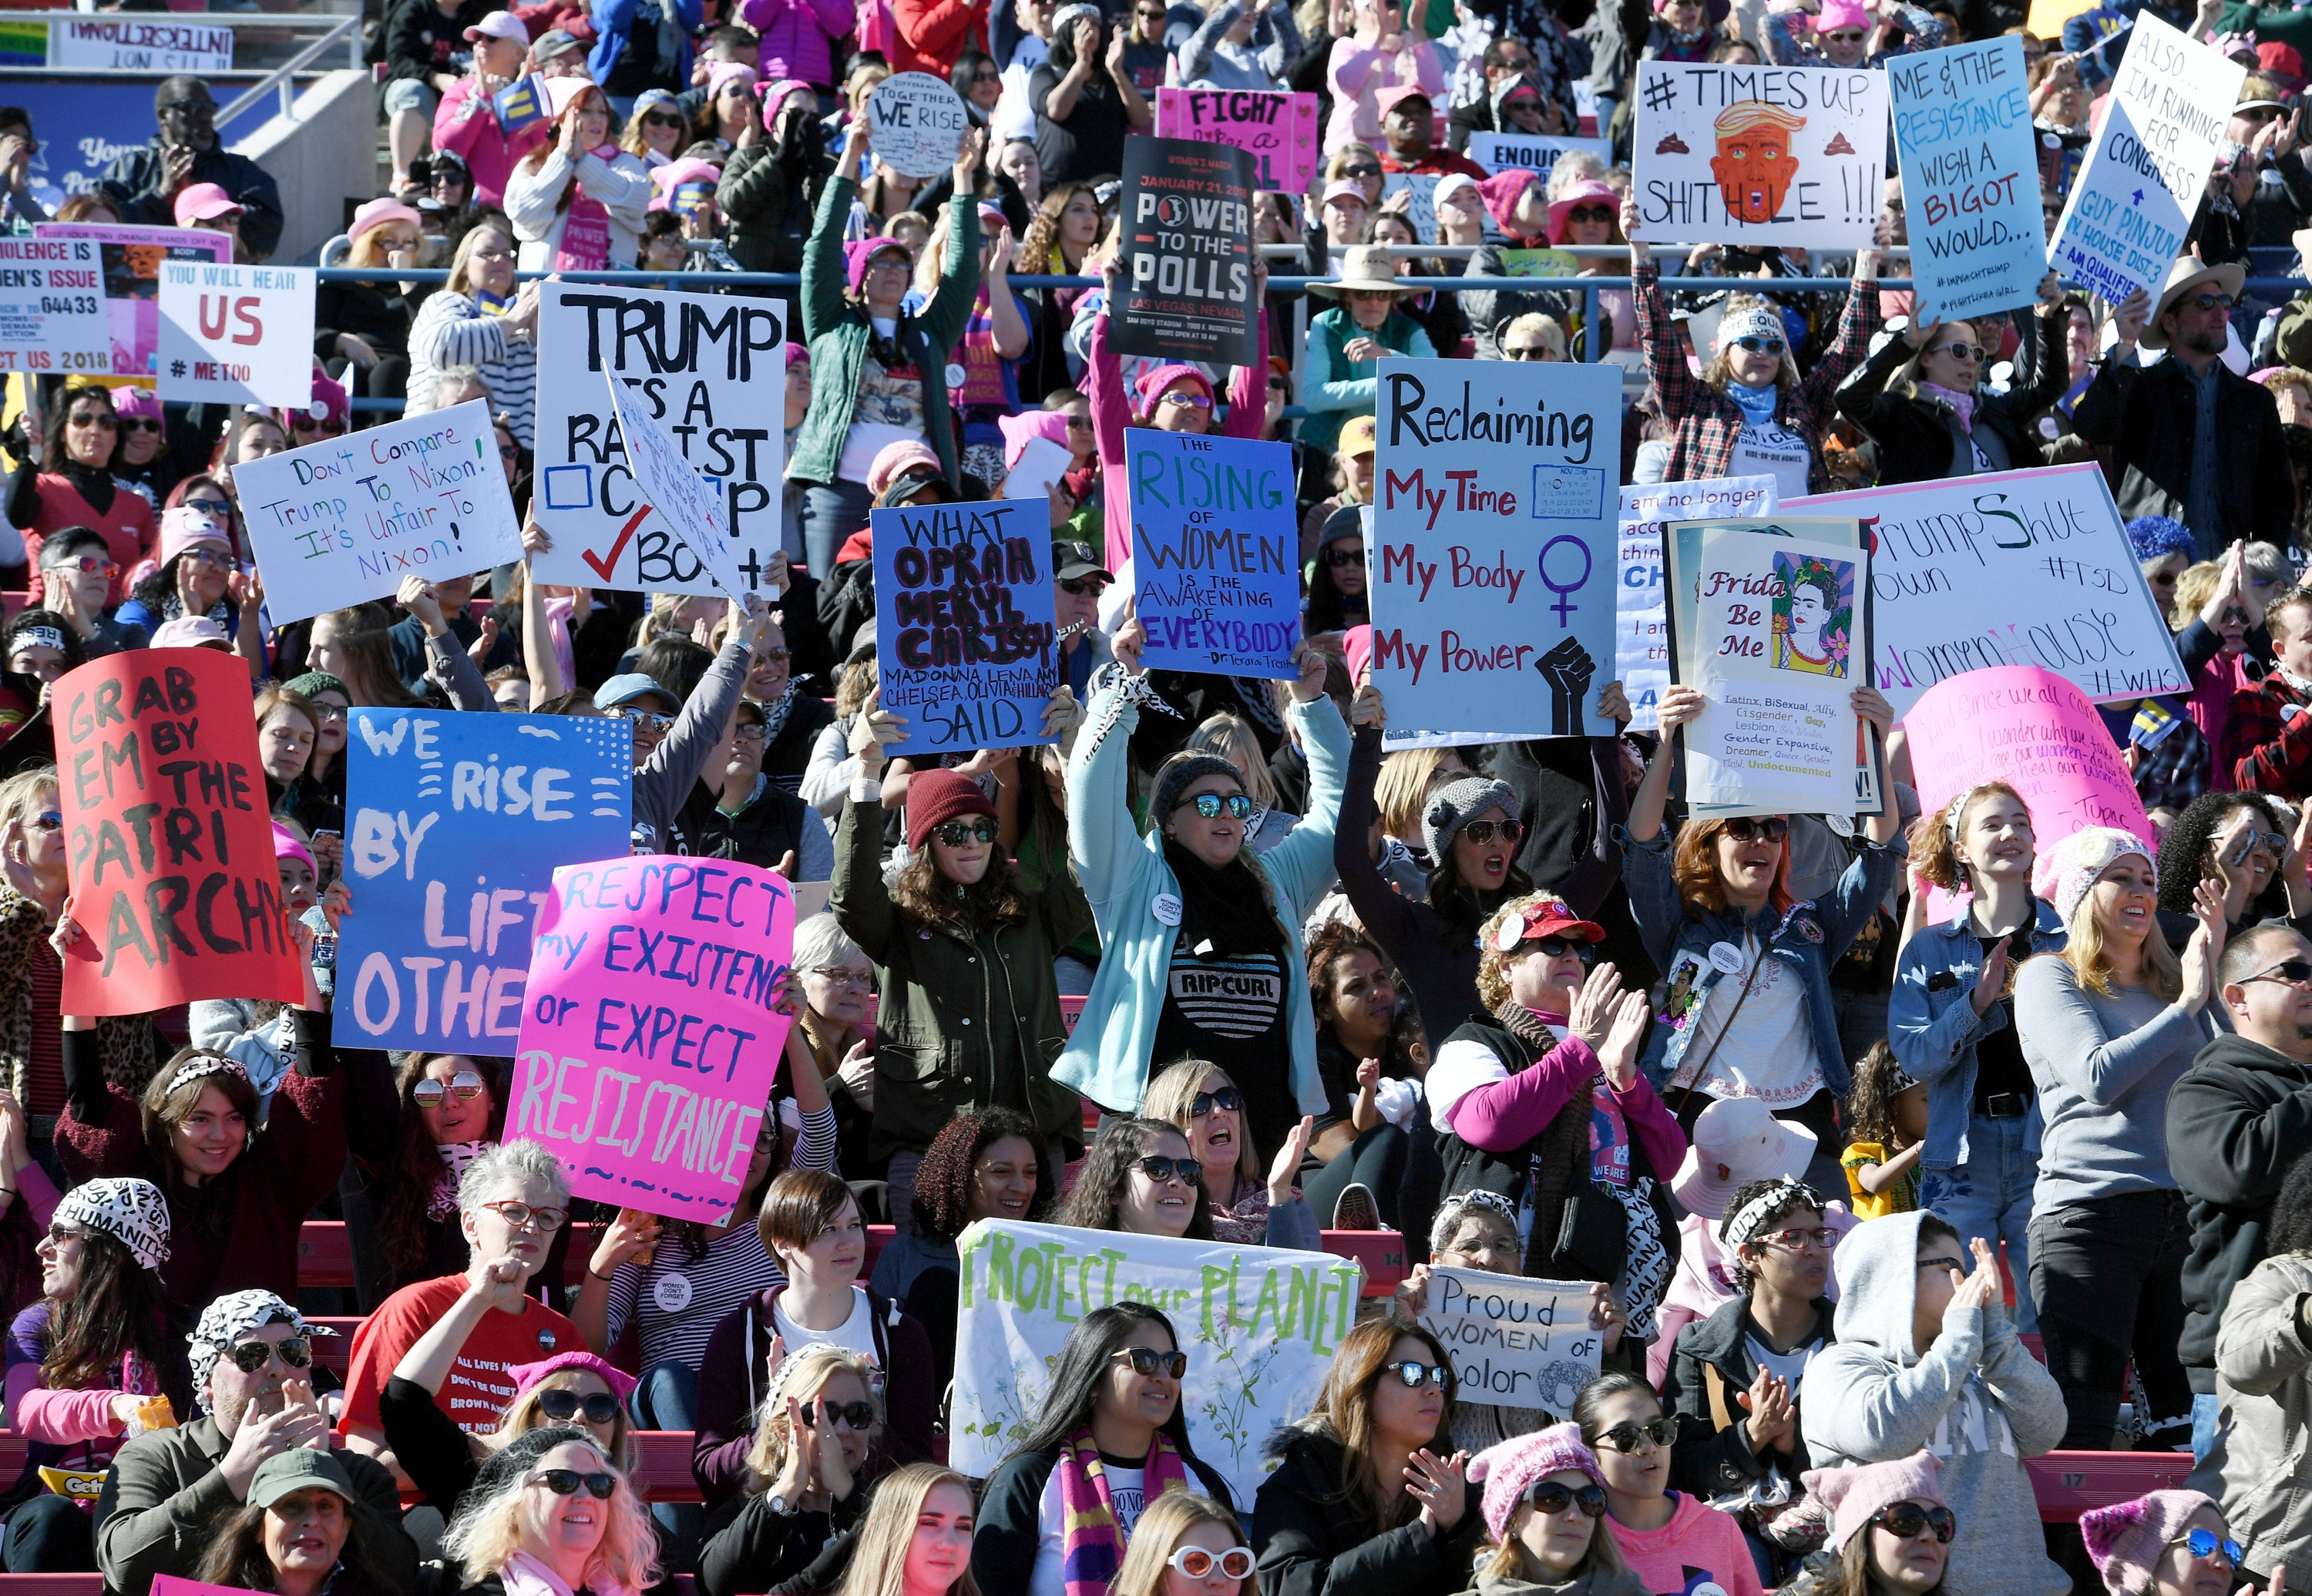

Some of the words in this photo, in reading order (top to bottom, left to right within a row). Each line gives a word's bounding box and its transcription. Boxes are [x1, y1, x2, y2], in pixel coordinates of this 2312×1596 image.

[1685, 69, 1808, 109] TIMES
[1892, 62, 1934, 104] ME
[1960, 48, 2006, 97] THE
[877, 86, 958, 106] TOGETHER
[1189, 91, 1287, 125] FIGHT
[2124, 66, 2159, 109] I'M
[2162, 86, 2224, 146] RUNNING
[874, 99, 912, 128] WE
[918, 107, 963, 130] RISE
[1896, 86, 2027, 159] RESISTANCE
[1252, 132, 1280, 149] a
[2146, 118, 2179, 153] FOR
[1920, 151, 1973, 189] WISH
[1974, 141, 1998, 173] A
[2109, 133, 2196, 201] CONGRESS
[1141, 176, 1205, 192] JANUARY
[1924, 172, 2019, 227] BIGOT
[2081, 190, 2119, 227] GUY
[75, 244, 90, 260] IS
[157, 236, 187, 244] HANDS
[173, 247, 197, 256] BODY
[1157, 231, 1185, 250] TO
[1191, 235, 1232, 256] THE
[2055, 239, 2065, 254] I
[2067, 246, 2086, 269] AM
[2081, 224, 2126, 264] HOUSE
[2148, 264, 2162, 284] 3
[49, 270, 98, 287] ISSUE
[166, 265, 196, 284] YOU
[204, 267, 242, 287] WILL
[253, 270, 296, 290] HEAR
[1131, 253, 1248, 302] POLLS
[2072, 268, 2096, 293] FOR
[42, 297, 97, 314] 64433
[199, 294, 263, 346] US
[1129, 298, 1151, 309] LAS
[1201, 305, 1245, 319] NEVADA
[1156, 318, 1182, 328] STADIUM
[560, 293, 782, 384] TRUMP
[29, 351, 52, 368] US
[62, 352, 108, 368] 2018
[684, 380, 714, 428] A
[1386, 373, 1594, 464] Reclaiming
[291, 449, 355, 486] Don't
[370, 425, 464, 465] Compare
[1177, 436, 1212, 452] THE
[260, 497, 349, 529] Trump
[355, 474, 391, 503] To
[408, 438, 486, 493] Nixon!
[1137, 449, 1283, 512] RISING
[1386, 469, 1446, 530] My
[1446, 469, 1517, 516] Time
[1631, 496, 1660, 510] am
[1668, 493, 1693, 507] no
[1699, 488, 1766, 509] longer
[294, 529, 355, 561] It's
[364, 502, 439, 543] Unfair
[439, 489, 476, 520] To
[900, 509, 1014, 548] WHAT
[1189, 511, 1215, 525] OF
[358, 521, 465, 581] Nixon!
[1136, 524, 1285, 575] WOMEN
[1178, 574, 1194, 588] IS
[1208, 574, 1242, 590] THE
[1383, 543, 1438, 603] My
[1447, 545, 1526, 604] Body
[1704, 570, 1787, 598] Frida
[1140, 582, 1274, 609] AWAKENING
[1191, 607, 1215, 622] OF
[1727, 603, 1762, 627] Be
[896, 621, 1054, 670] CHRISSY
[1144, 616, 1298, 654] EVERYBODY
[1718, 634, 1765, 658] Me
[1374, 628, 1429, 686] My
[1441, 630, 1535, 674] Power
[68, 666, 197, 744] GRAB
[967, 680, 1012, 701] OLIVIA
[1725, 695, 1762, 707] Latinx,
[1765, 697, 1810, 713] BiSexual,
[2008, 686, 2039, 705] we
[150, 717, 199, 757] BY
[358, 714, 440, 760] WE
[1724, 733, 1771, 744] Gender
[1776, 737, 1833, 755] Expansive,
[1988, 719, 2038, 749] wonder
[1726, 745, 1772, 758] Dreamer,
[1803, 754, 1831, 764] Gender
[1748, 760, 1831, 778] Undocumented
[2020, 760, 2053, 780] heal
[157, 760, 253, 811] THE
[72, 802, 230, 888] PATRI
[351, 807, 439, 881] BY
[563, 862, 786, 938] RESPECT
[1158, 906, 1181, 917] FORGET
[1160, 898, 1181, 909] WOMEN
[1161, 903, 1179, 912] DON'T
[101, 872, 288, 979] ARCHY
[535, 929, 589, 971] my
[536, 993, 580, 1030] or
[593, 997, 756, 1082] EXPECT
[517, 1049, 764, 1187] RESISTANCE
[1594, 1166, 1609, 1176] WE
[1610, 1168, 1626, 1180] ARE
[1385, 1253, 1401, 1266] 14
[660, 1292, 685, 1301] FORGET
[661, 1282, 685, 1291] WOMEN
[962, 1229, 1126, 1323] PROTECT
[1201, 1254, 1360, 1357] PLANET
[1437, 1274, 1558, 1328] Proud
[1426, 1315, 1550, 1352] WOMEN
[1571, 1338, 1597, 1357] OF
[458, 1356, 472, 1369] ALL
[475, 1358, 499, 1372] LIVES
[450, 1374, 476, 1389] DON'T
[477, 1381, 489, 1392] BE
[490, 1384, 517, 1396] QUIET
[450, 1398, 490, 1409] BROWN
[475, 1423, 496, 1433] NOT
[2065, 1473, 2084, 1487] 17
